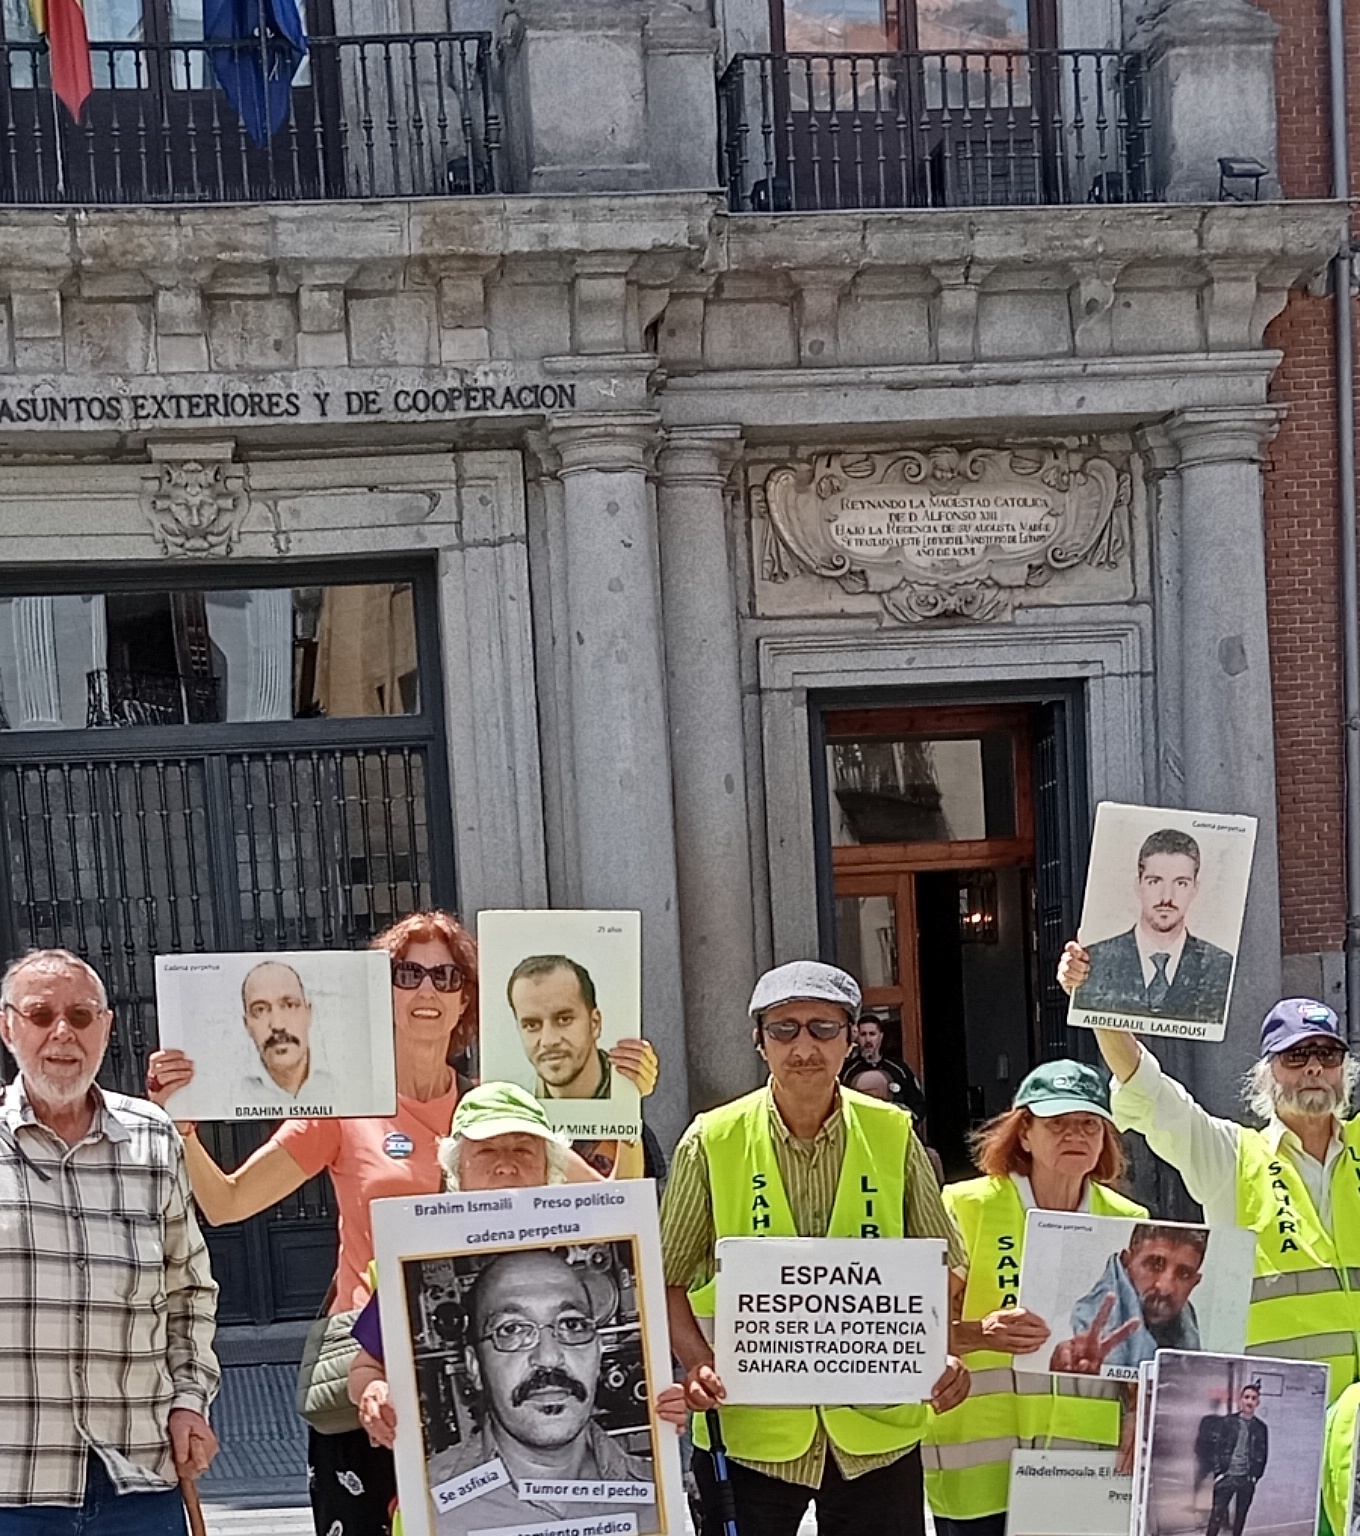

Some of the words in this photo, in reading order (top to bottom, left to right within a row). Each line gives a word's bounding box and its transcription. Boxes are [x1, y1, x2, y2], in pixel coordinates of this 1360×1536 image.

[132, 393, 300, 421] EXTERIORES
[317, 391, 331, 417] Y
[345, 389, 382, 415] DE
[393, 384, 577, 413] COOPERACION
[909, 498, 926, 509] LA
[922, 510, 977, 522] ALFONSO
[235, 1106, 284, 1118] BRAHIM
[289, 1105, 334, 1117] ISMAILI
[600, 1124, 638, 1136] HADDI
[414, 1200, 465, 1217] Brahim
[533, 1196, 572, 1209] Preso
[575, 1193, 625, 1210] político
[466, 1228, 515, 1244] cadena
[519, 1221, 581, 1241] perpetua
[780, 1261, 882, 1286] ESPAÑA
[738, 1294, 924, 1315] RESPONSABLE
[734, 1321, 770, 1335] POR
[774, 1321, 809, 1335] SER
[814, 1321, 836, 1335] LA
[841, 1321, 927, 1336] POTENCIA
[734, 1340, 888, 1355] ADMINISTRADORA
[893, 1340, 926, 1354] DEL
[738, 1359, 809, 1374] SAHARA
[813, 1359, 923, 1374] OCCIDENTAL
[438, 1489, 457, 1505] Se
[458, 1468, 501, 1497] asfixia
[524, 1482, 569, 1496] Tumor
[572, 1484, 589, 1496] en
[592, 1482, 605, 1496] el
[607, 1482, 649, 1498] pecho
